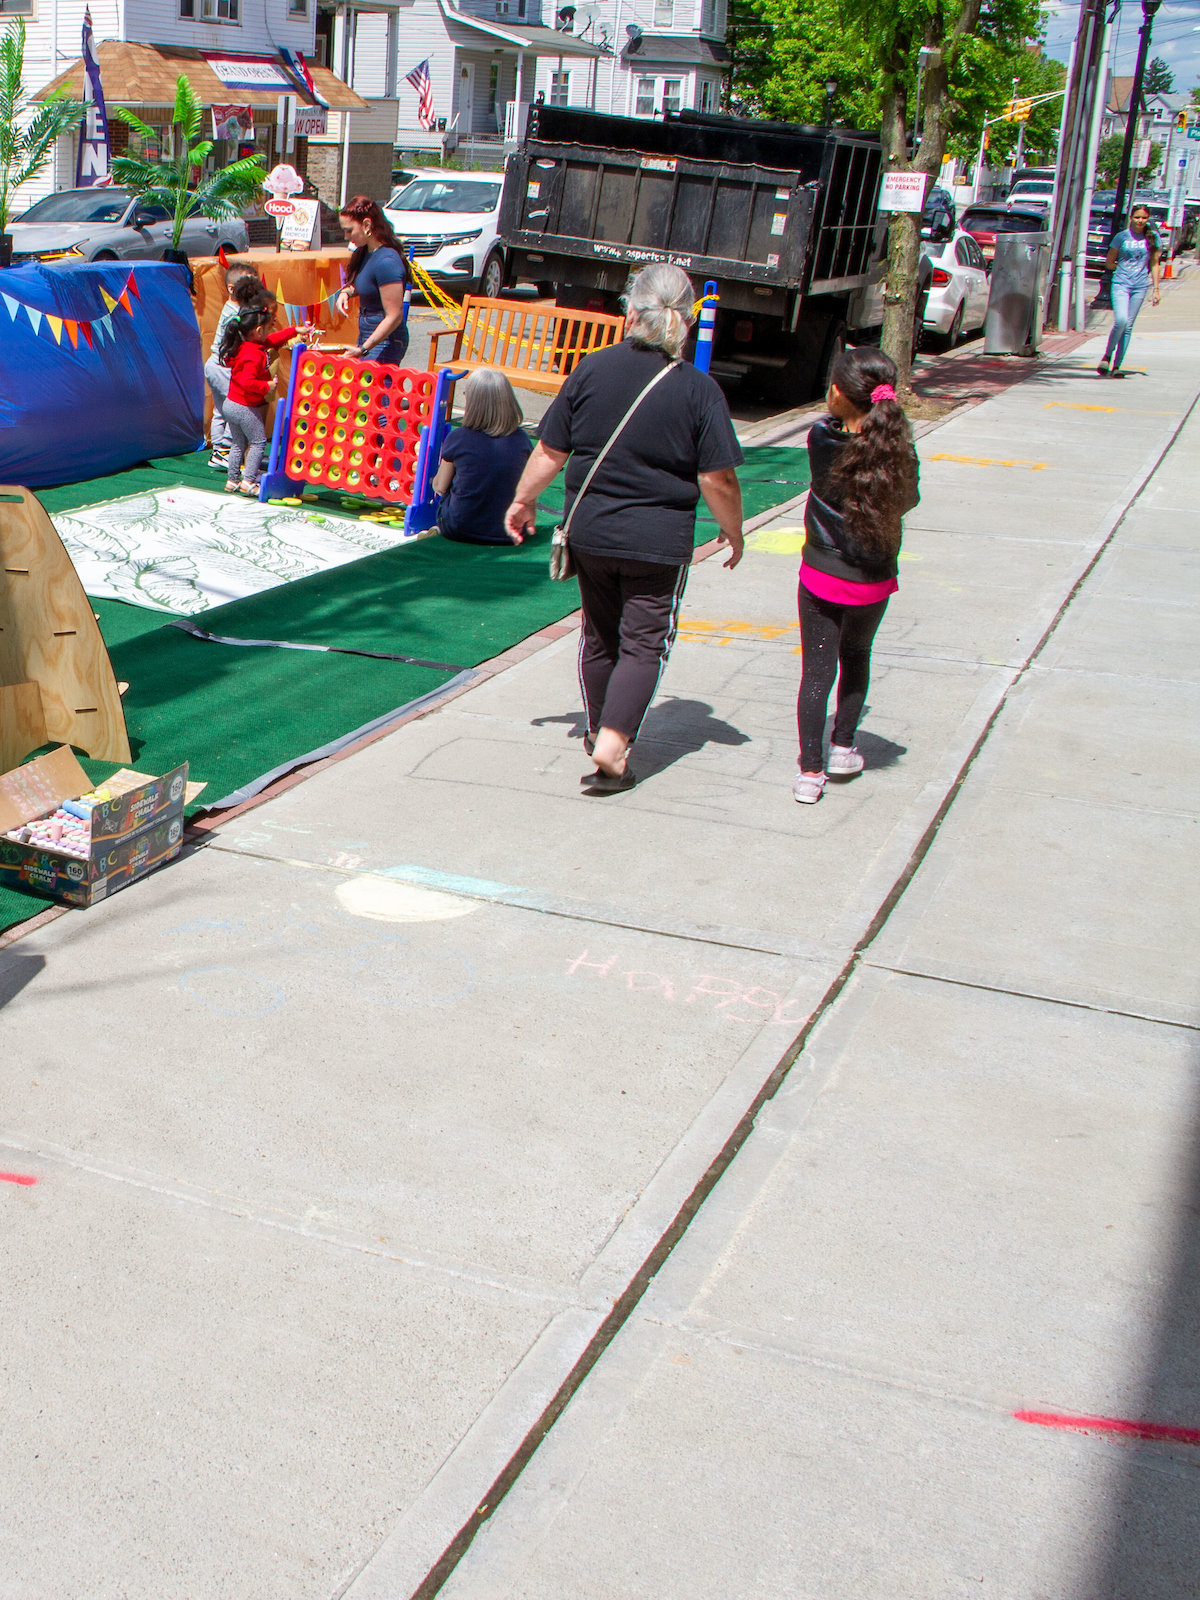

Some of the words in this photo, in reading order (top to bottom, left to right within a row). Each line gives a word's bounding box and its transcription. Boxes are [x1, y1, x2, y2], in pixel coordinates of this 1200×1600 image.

[305, 119, 326, 134] OPEN
[268, 203, 293, 213] Hood
[171, 780, 182, 793] 160
[130, 792, 160, 813] SIDEWALK
[134, 803, 155, 819] CHALK
[170, 825, 180, 835] 160
[128, 849, 149, 865] SIDEWALK
[132, 857, 146, 869] CHALK
[23, 864, 57, 878] SIDEWALK
[68, 866, 82, 875] 160
[29, 873, 52, 883] CHALK
